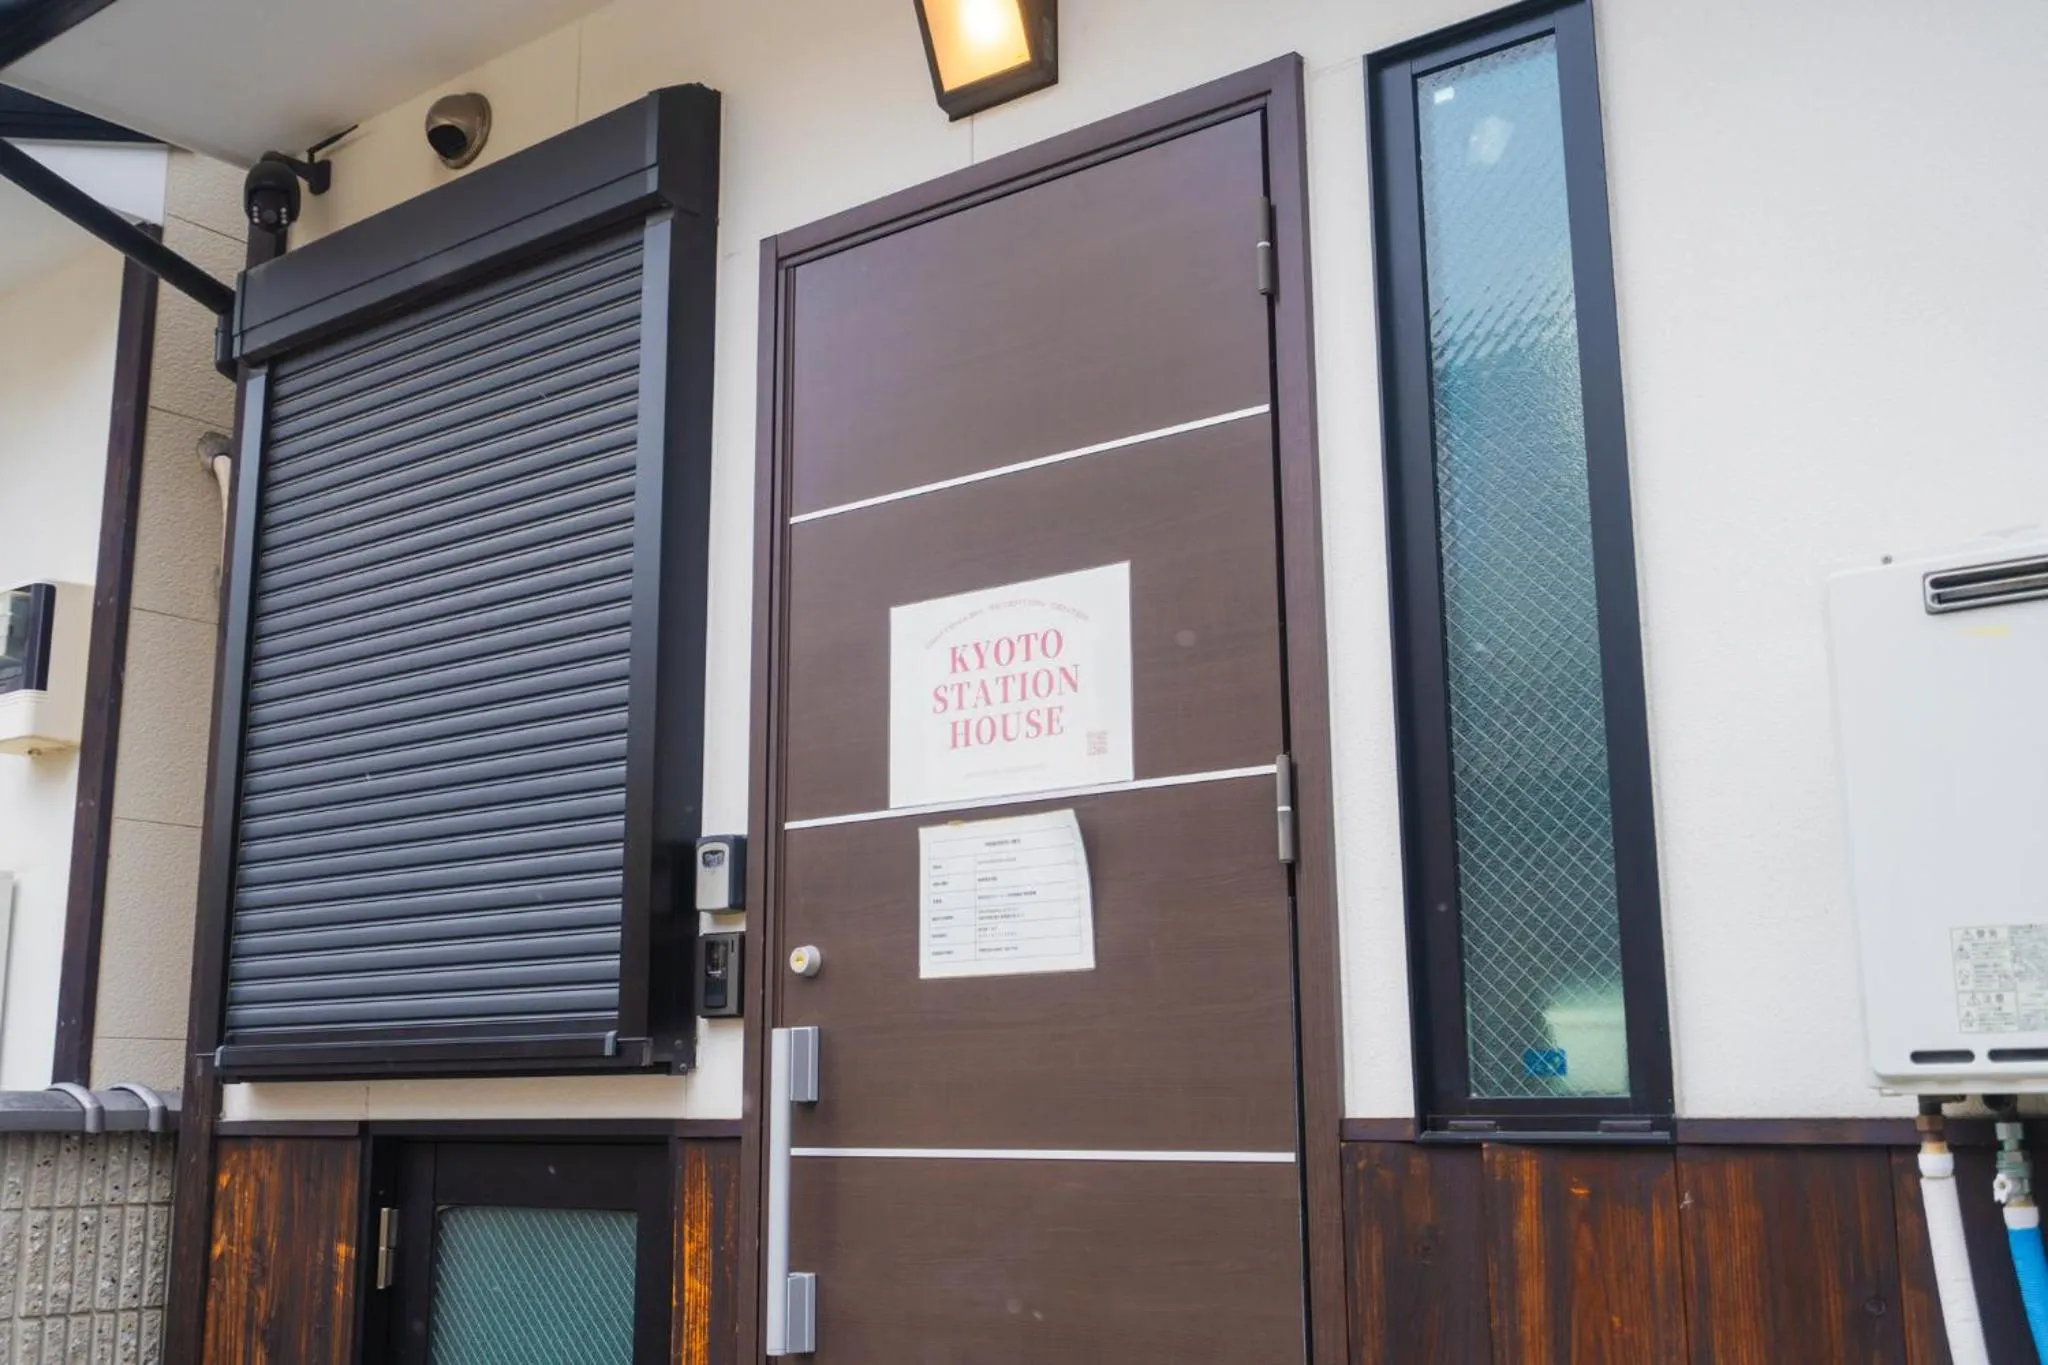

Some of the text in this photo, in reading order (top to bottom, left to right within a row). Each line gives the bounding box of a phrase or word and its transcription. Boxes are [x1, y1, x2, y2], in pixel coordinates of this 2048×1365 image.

[949, 628, 1064, 674] KYOTO
[932, 664, 1080, 714] STATION
[949, 705, 1064, 749] HOUSE
